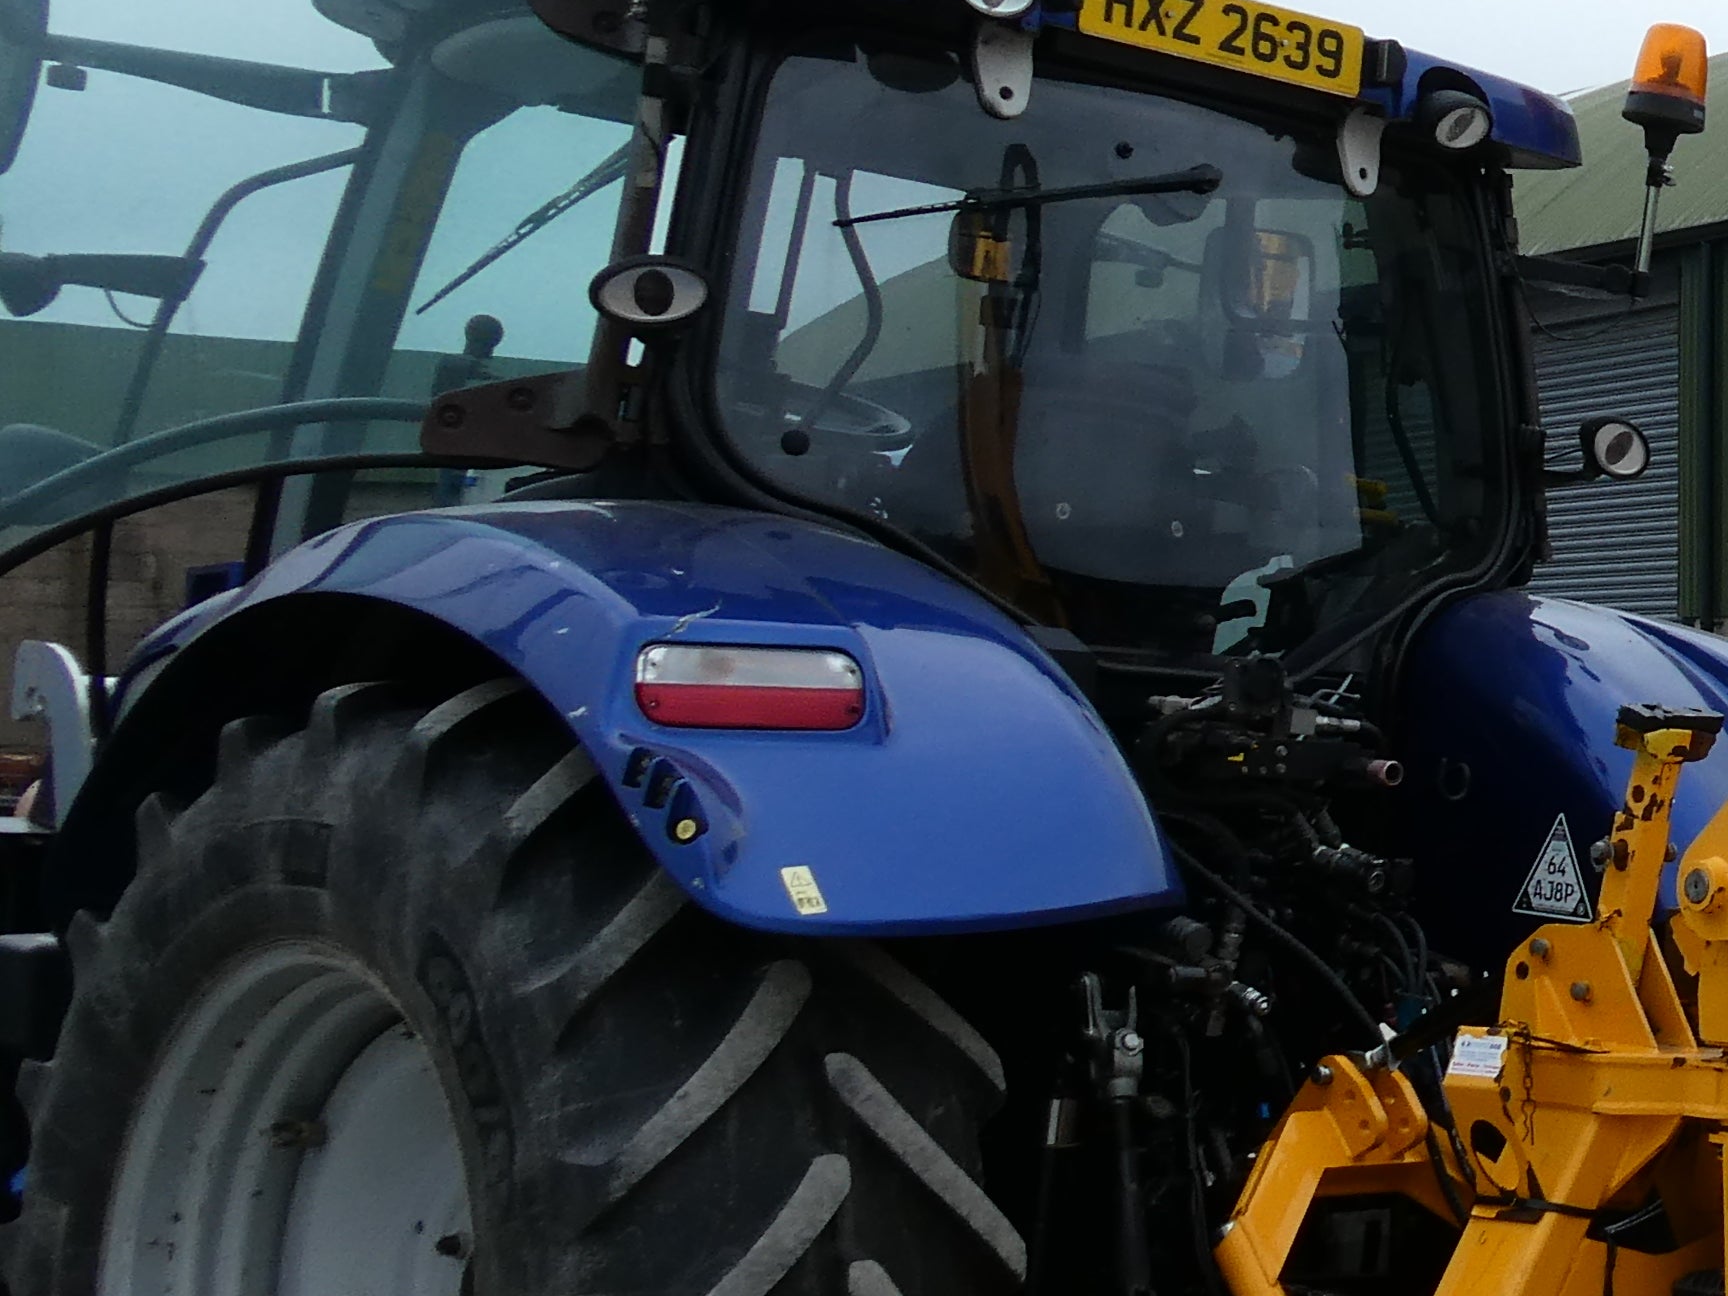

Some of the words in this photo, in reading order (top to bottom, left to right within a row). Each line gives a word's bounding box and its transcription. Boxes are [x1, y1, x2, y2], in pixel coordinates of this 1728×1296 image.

[1217, 3, 1344, 79] 2639
[1547, 855, 1567, 876] 64
[1533, 879, 1574, 903] AJ8P
